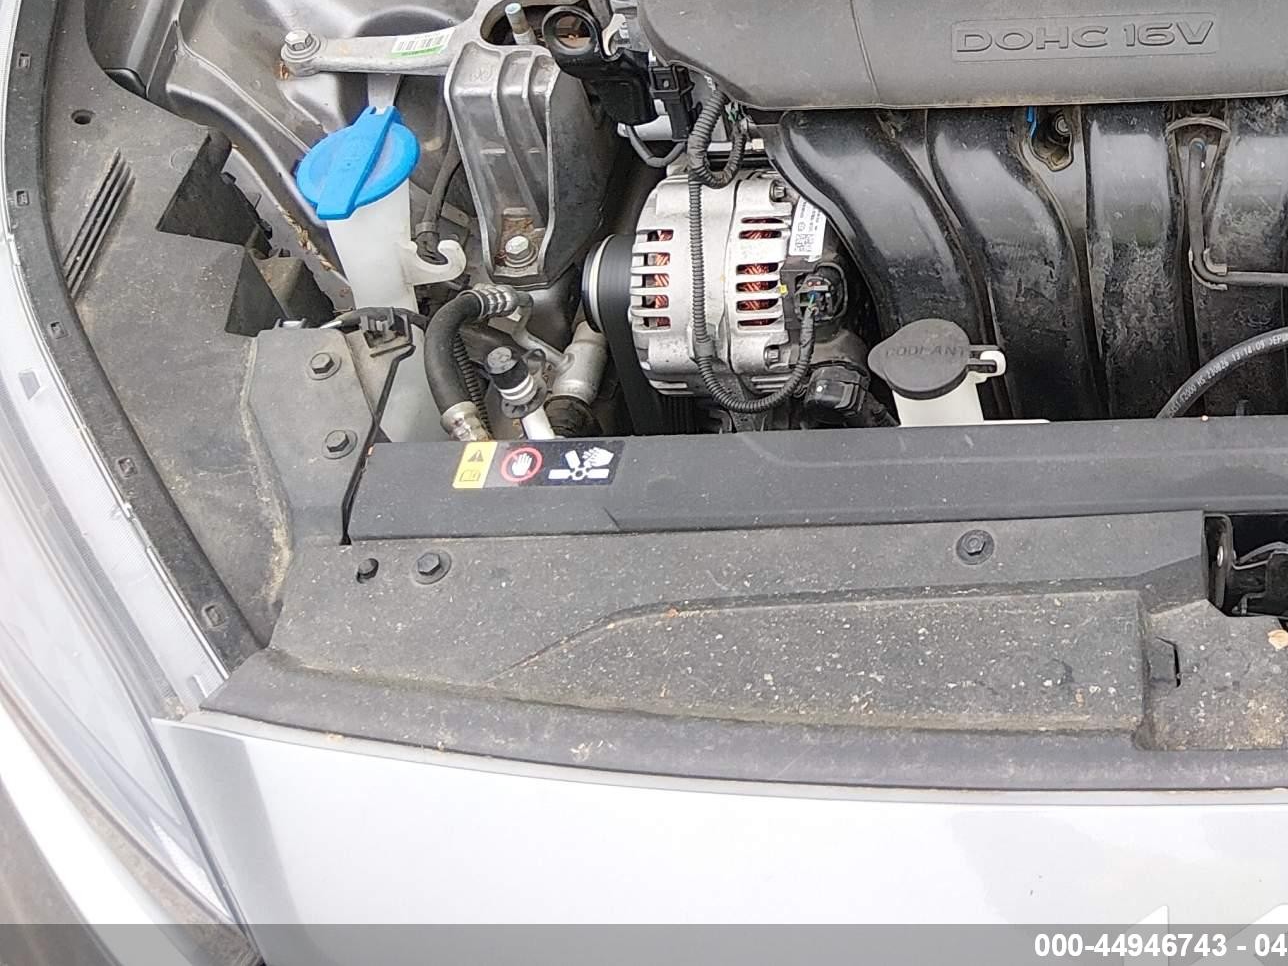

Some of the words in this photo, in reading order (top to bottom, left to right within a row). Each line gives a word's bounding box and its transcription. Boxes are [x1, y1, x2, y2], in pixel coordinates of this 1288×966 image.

[956, 25, 1109, 53] DOHC
[1123, 21, 1214, 48] 16V
[886, 344, 965, 358] COOLANT
